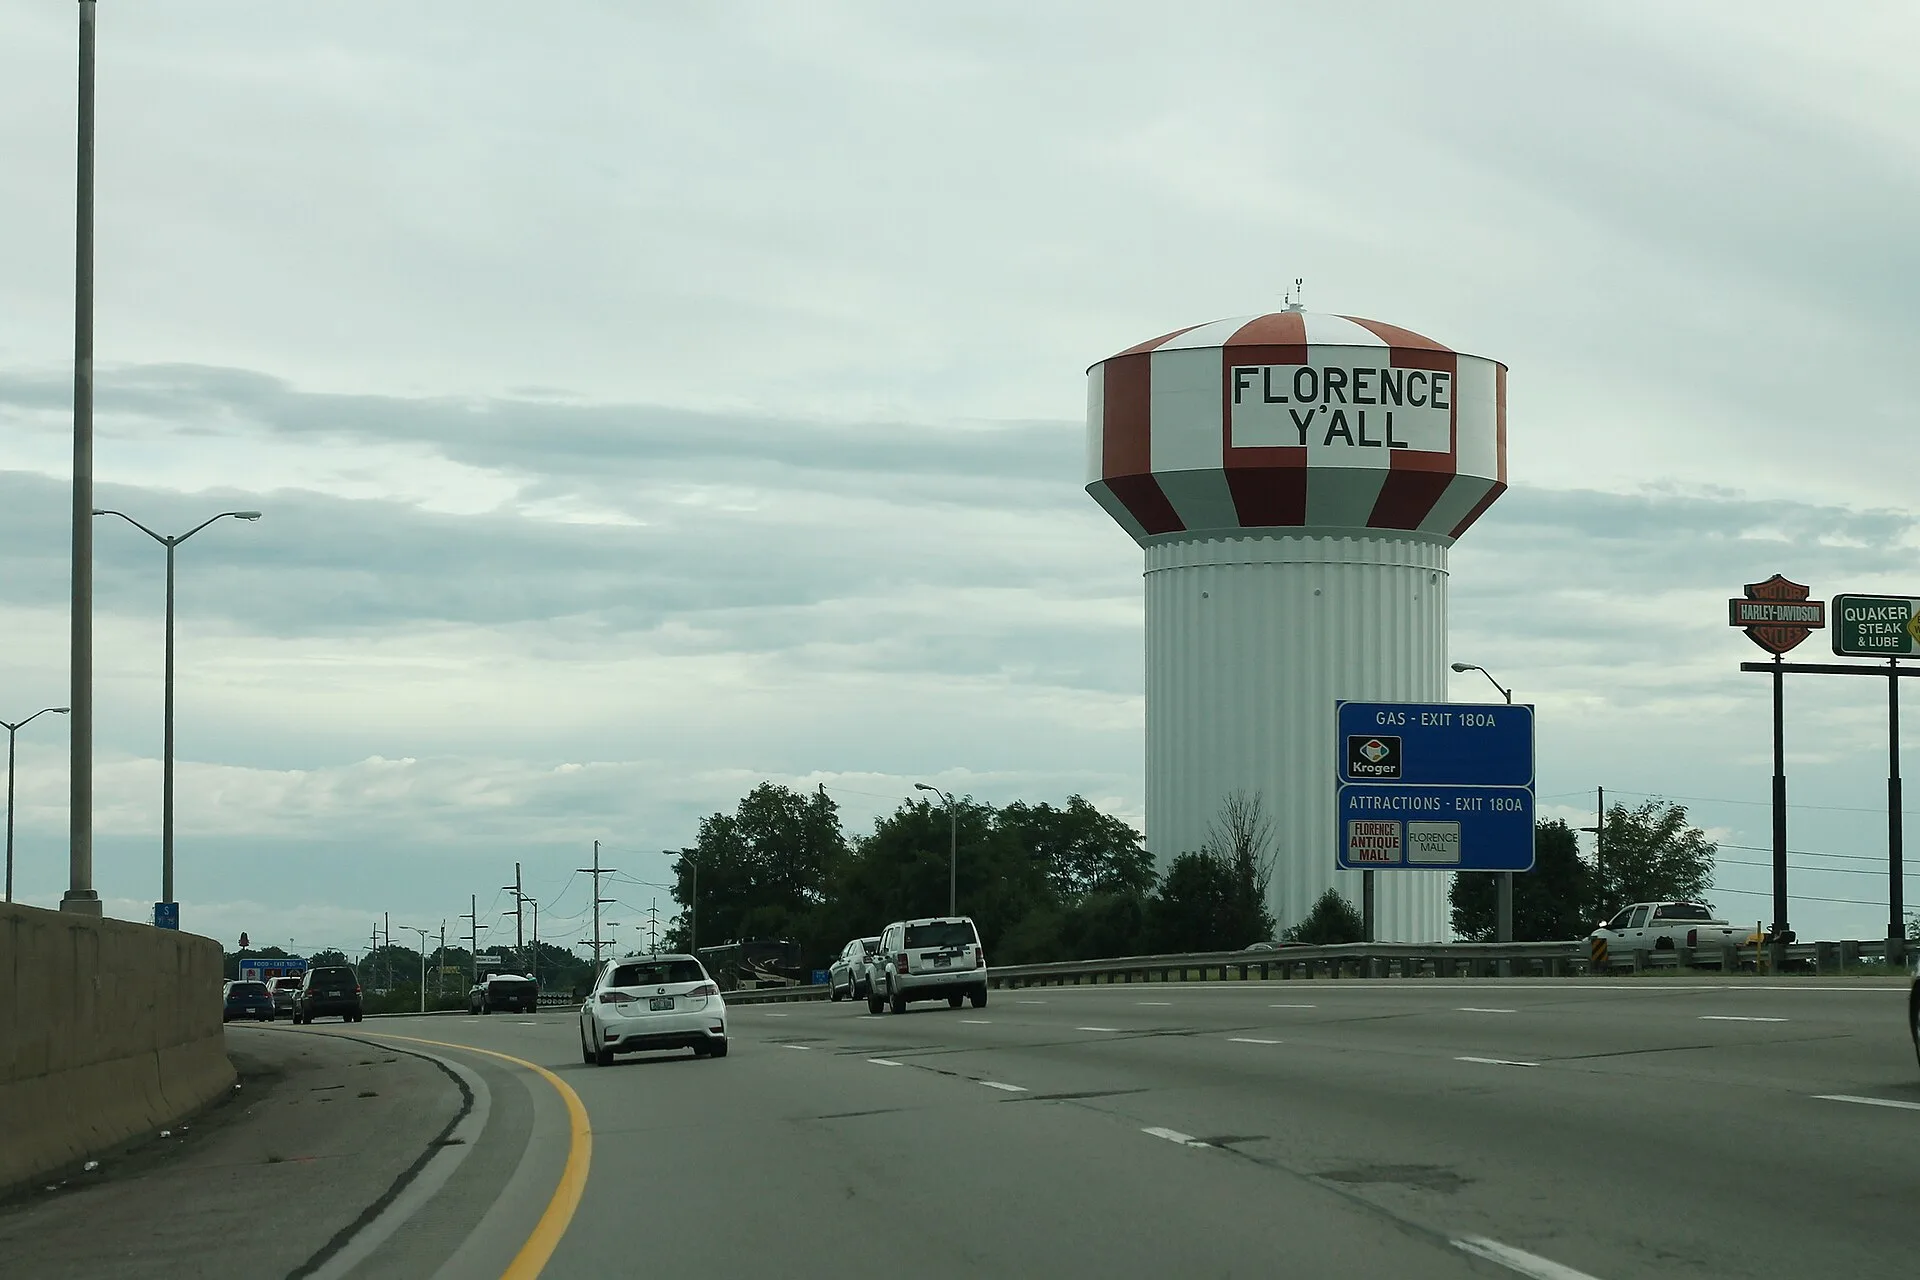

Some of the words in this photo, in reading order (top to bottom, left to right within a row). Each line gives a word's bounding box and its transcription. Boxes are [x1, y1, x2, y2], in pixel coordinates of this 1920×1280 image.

[1234, 366, 1449, 410] FLORENCE
[1288, 404, 1409, 449] Y'ALL
[1741, 604, 1820, 622] HARLEY-DAVIDSON
[1844, 606, 1908, 622] QUAKER
[1858, 622, 1902, 635] STEAK
[1858, 636, 1866, 647] &
[1869, 636, 1899, 647] LUBE
[1376, 711, 1406, 726] GAS
[1421, 713, 1452, 726] EXIT
[1459, 713, 1496, 727] 180A
[1353, 762, 1396, 775] Kroger
[1349, 796, 1441, 810] ATTRACTIONS
[1455, 798, 1483, 811] EXIT
[1489, 798, 1523, 811] 180A
[1354, 822, 1395, 836] FLORENCE
[1350, 836, 1399, 849] ANTIQUE
[1409, 832, 1459, 842] FLORENCE
[1420, 842, 1446, 852] MALL
[1359, 849, 1390, 861] MALL
